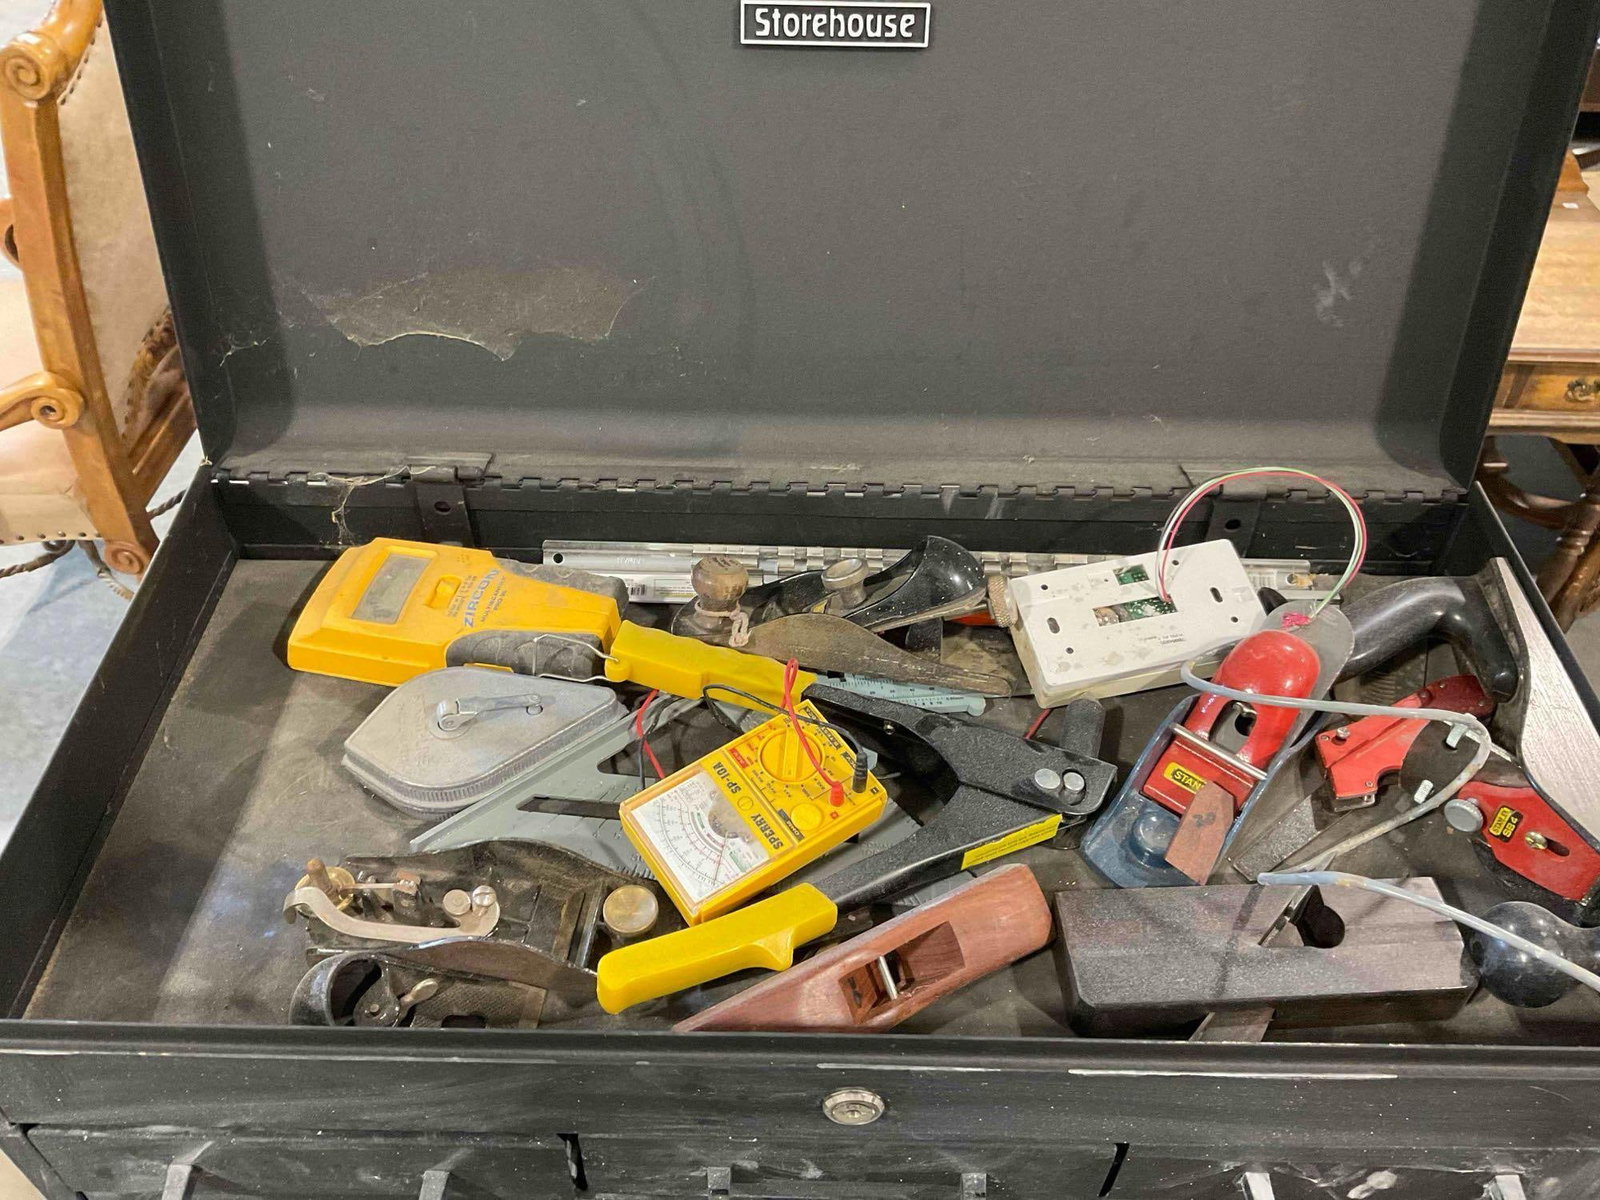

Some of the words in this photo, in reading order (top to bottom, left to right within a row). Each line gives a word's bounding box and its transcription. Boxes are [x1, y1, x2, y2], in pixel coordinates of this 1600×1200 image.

[755, 8, 915, 37] Storehouse
[464, 568, 500, 628] ZIRCON
[712, 761, 742, 794] SP-10A
[1173, 770, 1204, 790] STAN
[751, 813, 784, 850] SPERRY
